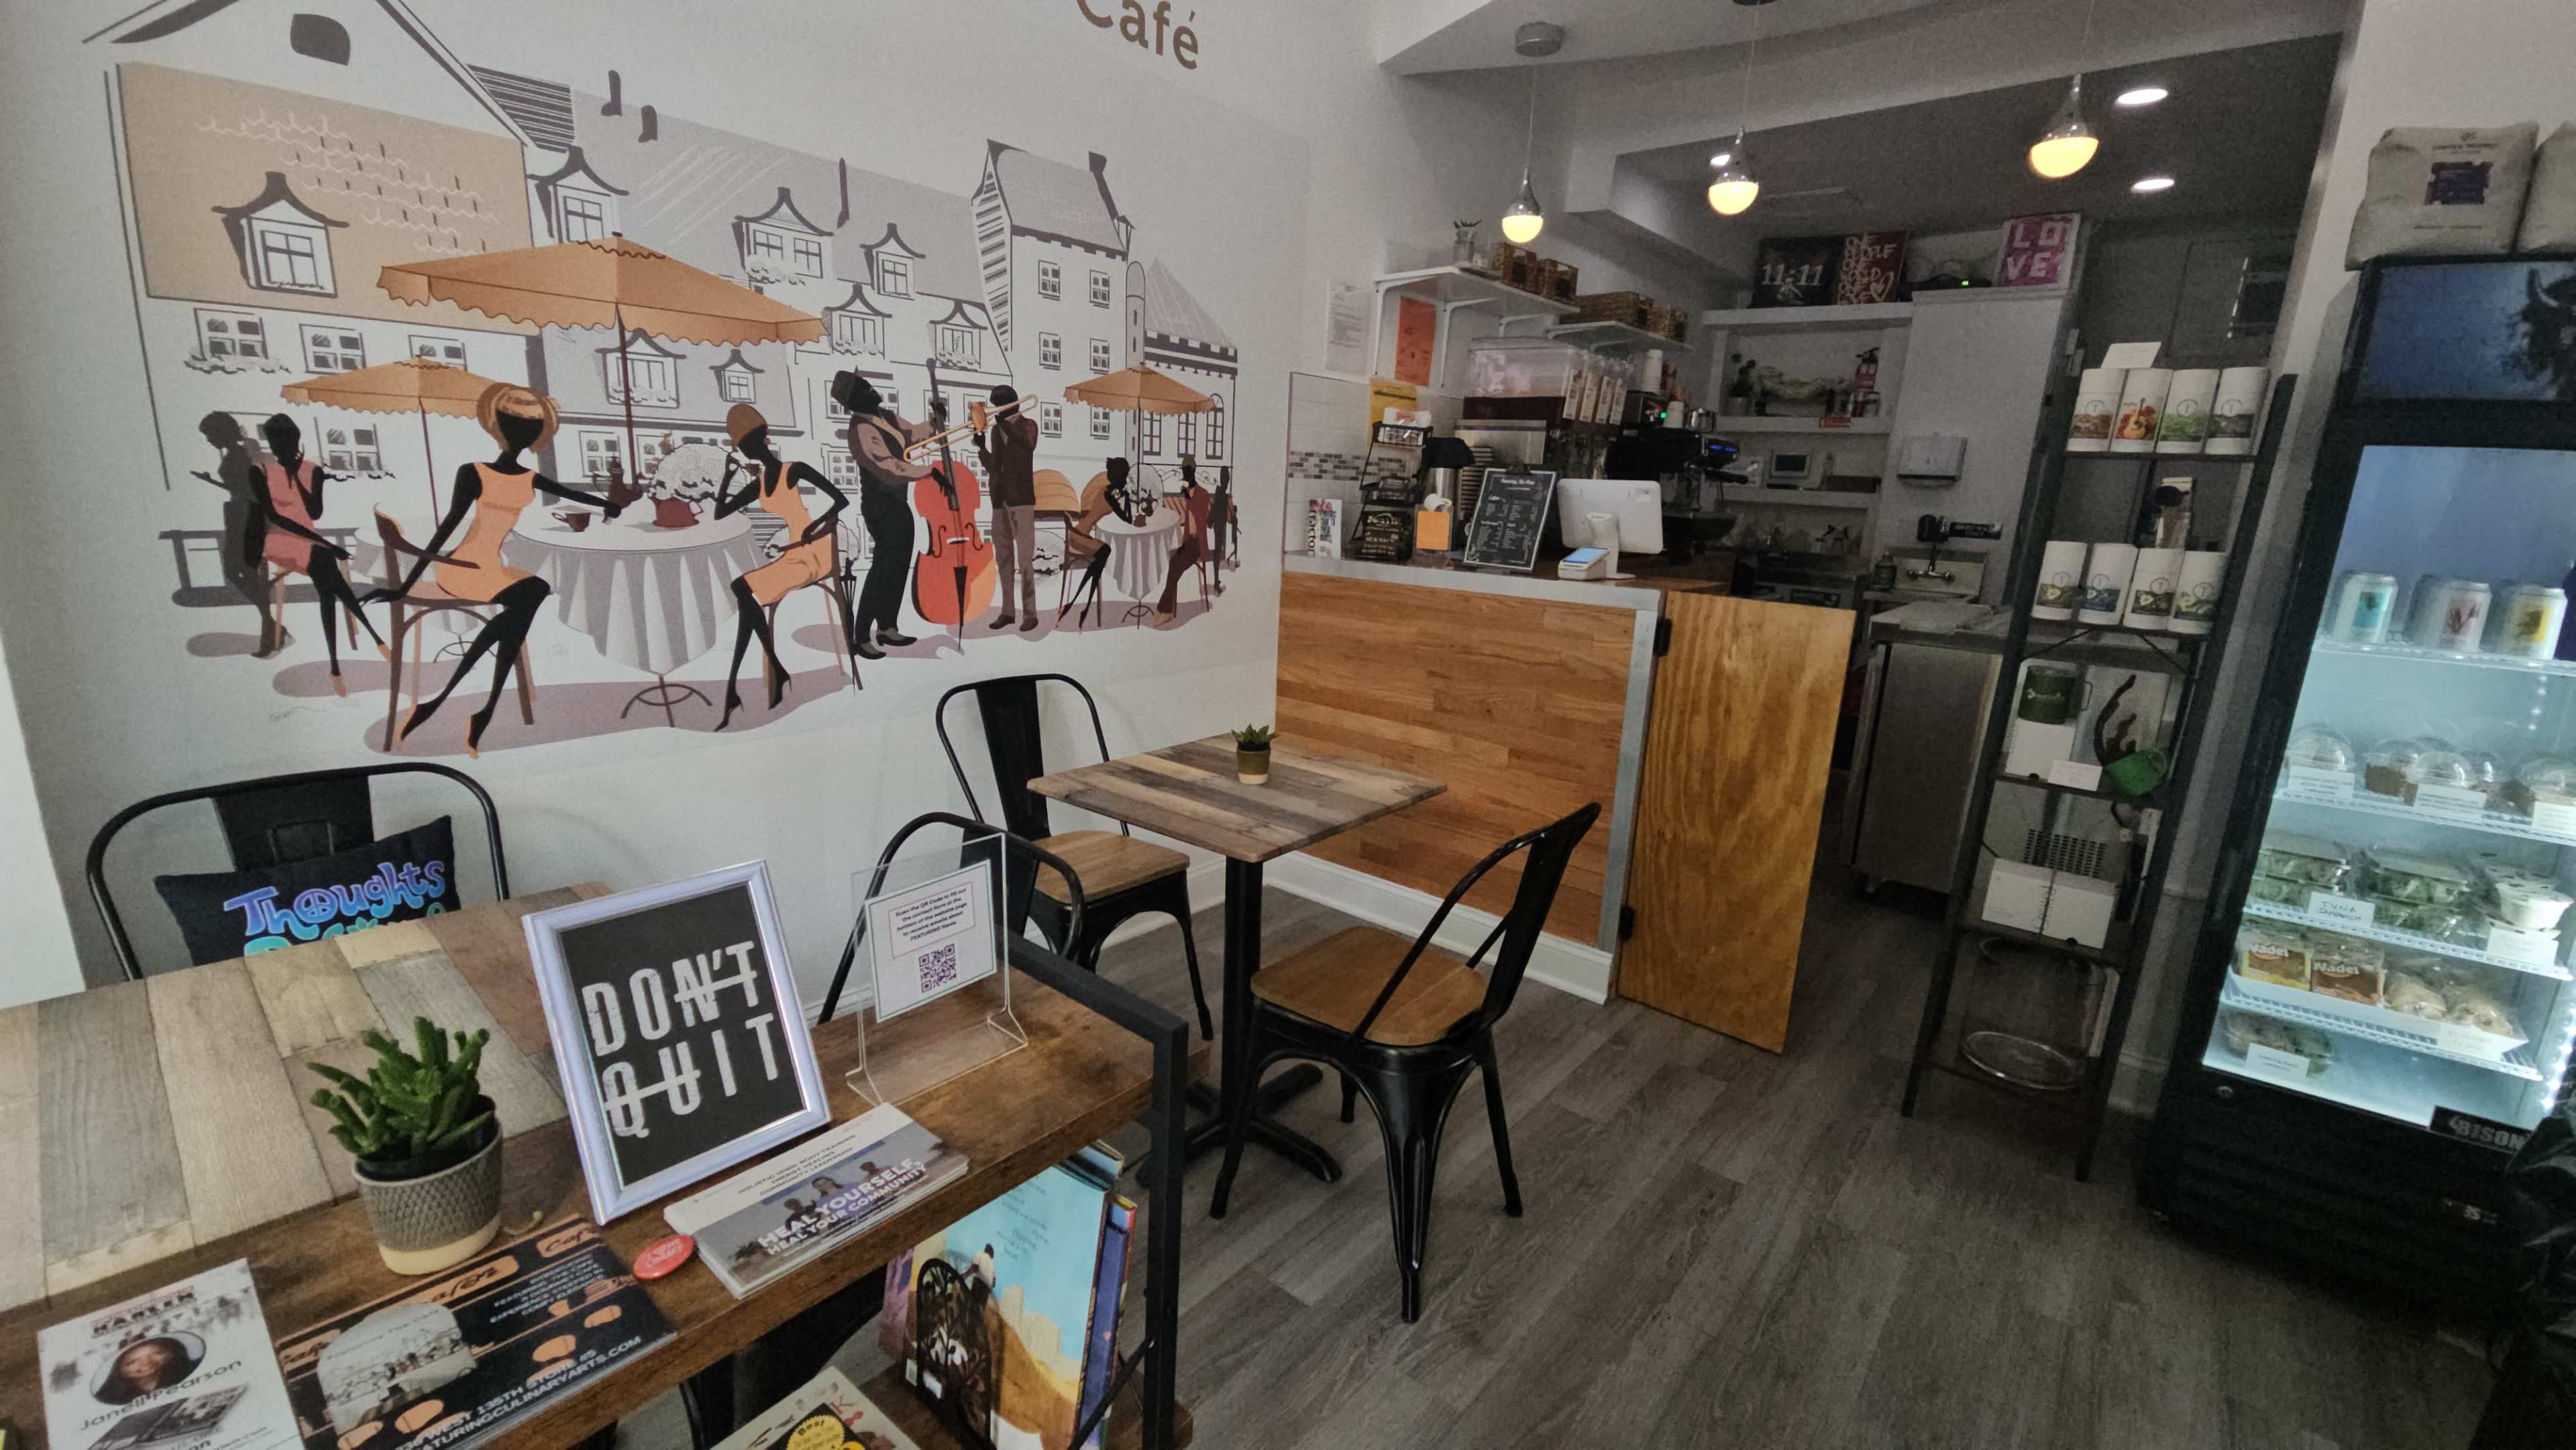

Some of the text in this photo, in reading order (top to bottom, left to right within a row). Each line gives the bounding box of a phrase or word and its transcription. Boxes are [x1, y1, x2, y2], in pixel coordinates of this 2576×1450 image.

[223, 860, 446, 940] Thoughts
[897, 921, 917, 932] bottom
[934, 907, 954, 917] website
[955, 902, 967, 911] page
[912, 908, 932, 919] contact
[582, 940, 758, 1057] DON'T
[604, 1013, 778, 1139] QUIT
[757, 1158, 922, 1247] HEAL YOURSELF,
[767, 1164, 928, 1256] HEAL YOUR COMMUNITY
[151, 1359, 242, 1400] Pearson
[419, 1335, 643, 1450] ATURINGCULINARYARTS.COM
[422, 1410, 473, 1441] WEST
[476, 1384, 524, 1414] 135TH
[524, 1357, 578, 1390] STORE
